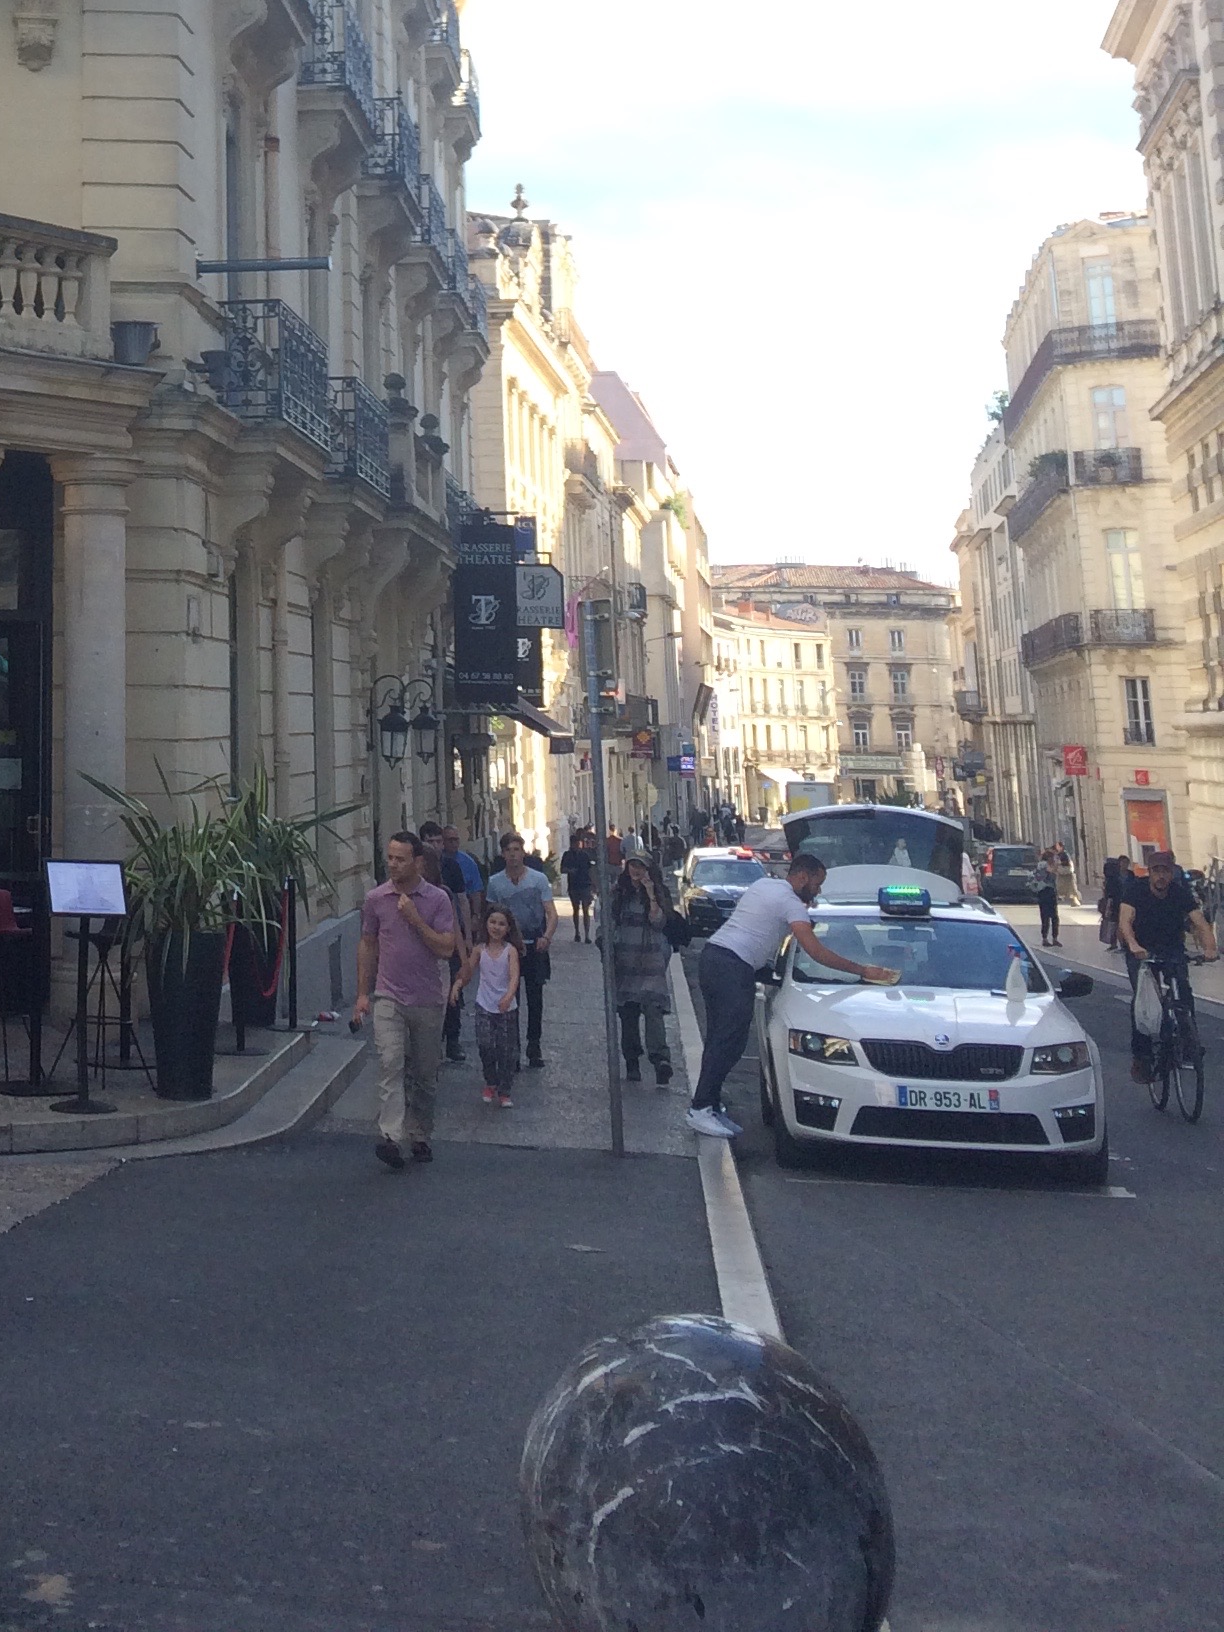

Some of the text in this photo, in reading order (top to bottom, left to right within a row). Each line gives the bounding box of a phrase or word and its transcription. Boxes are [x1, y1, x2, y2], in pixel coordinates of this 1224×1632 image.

[517, 606, 561, 615] RASSERIE
[517, 616, 561, 625] HEATRE
[909, 1089, 987, 1110] DR-953-AL
